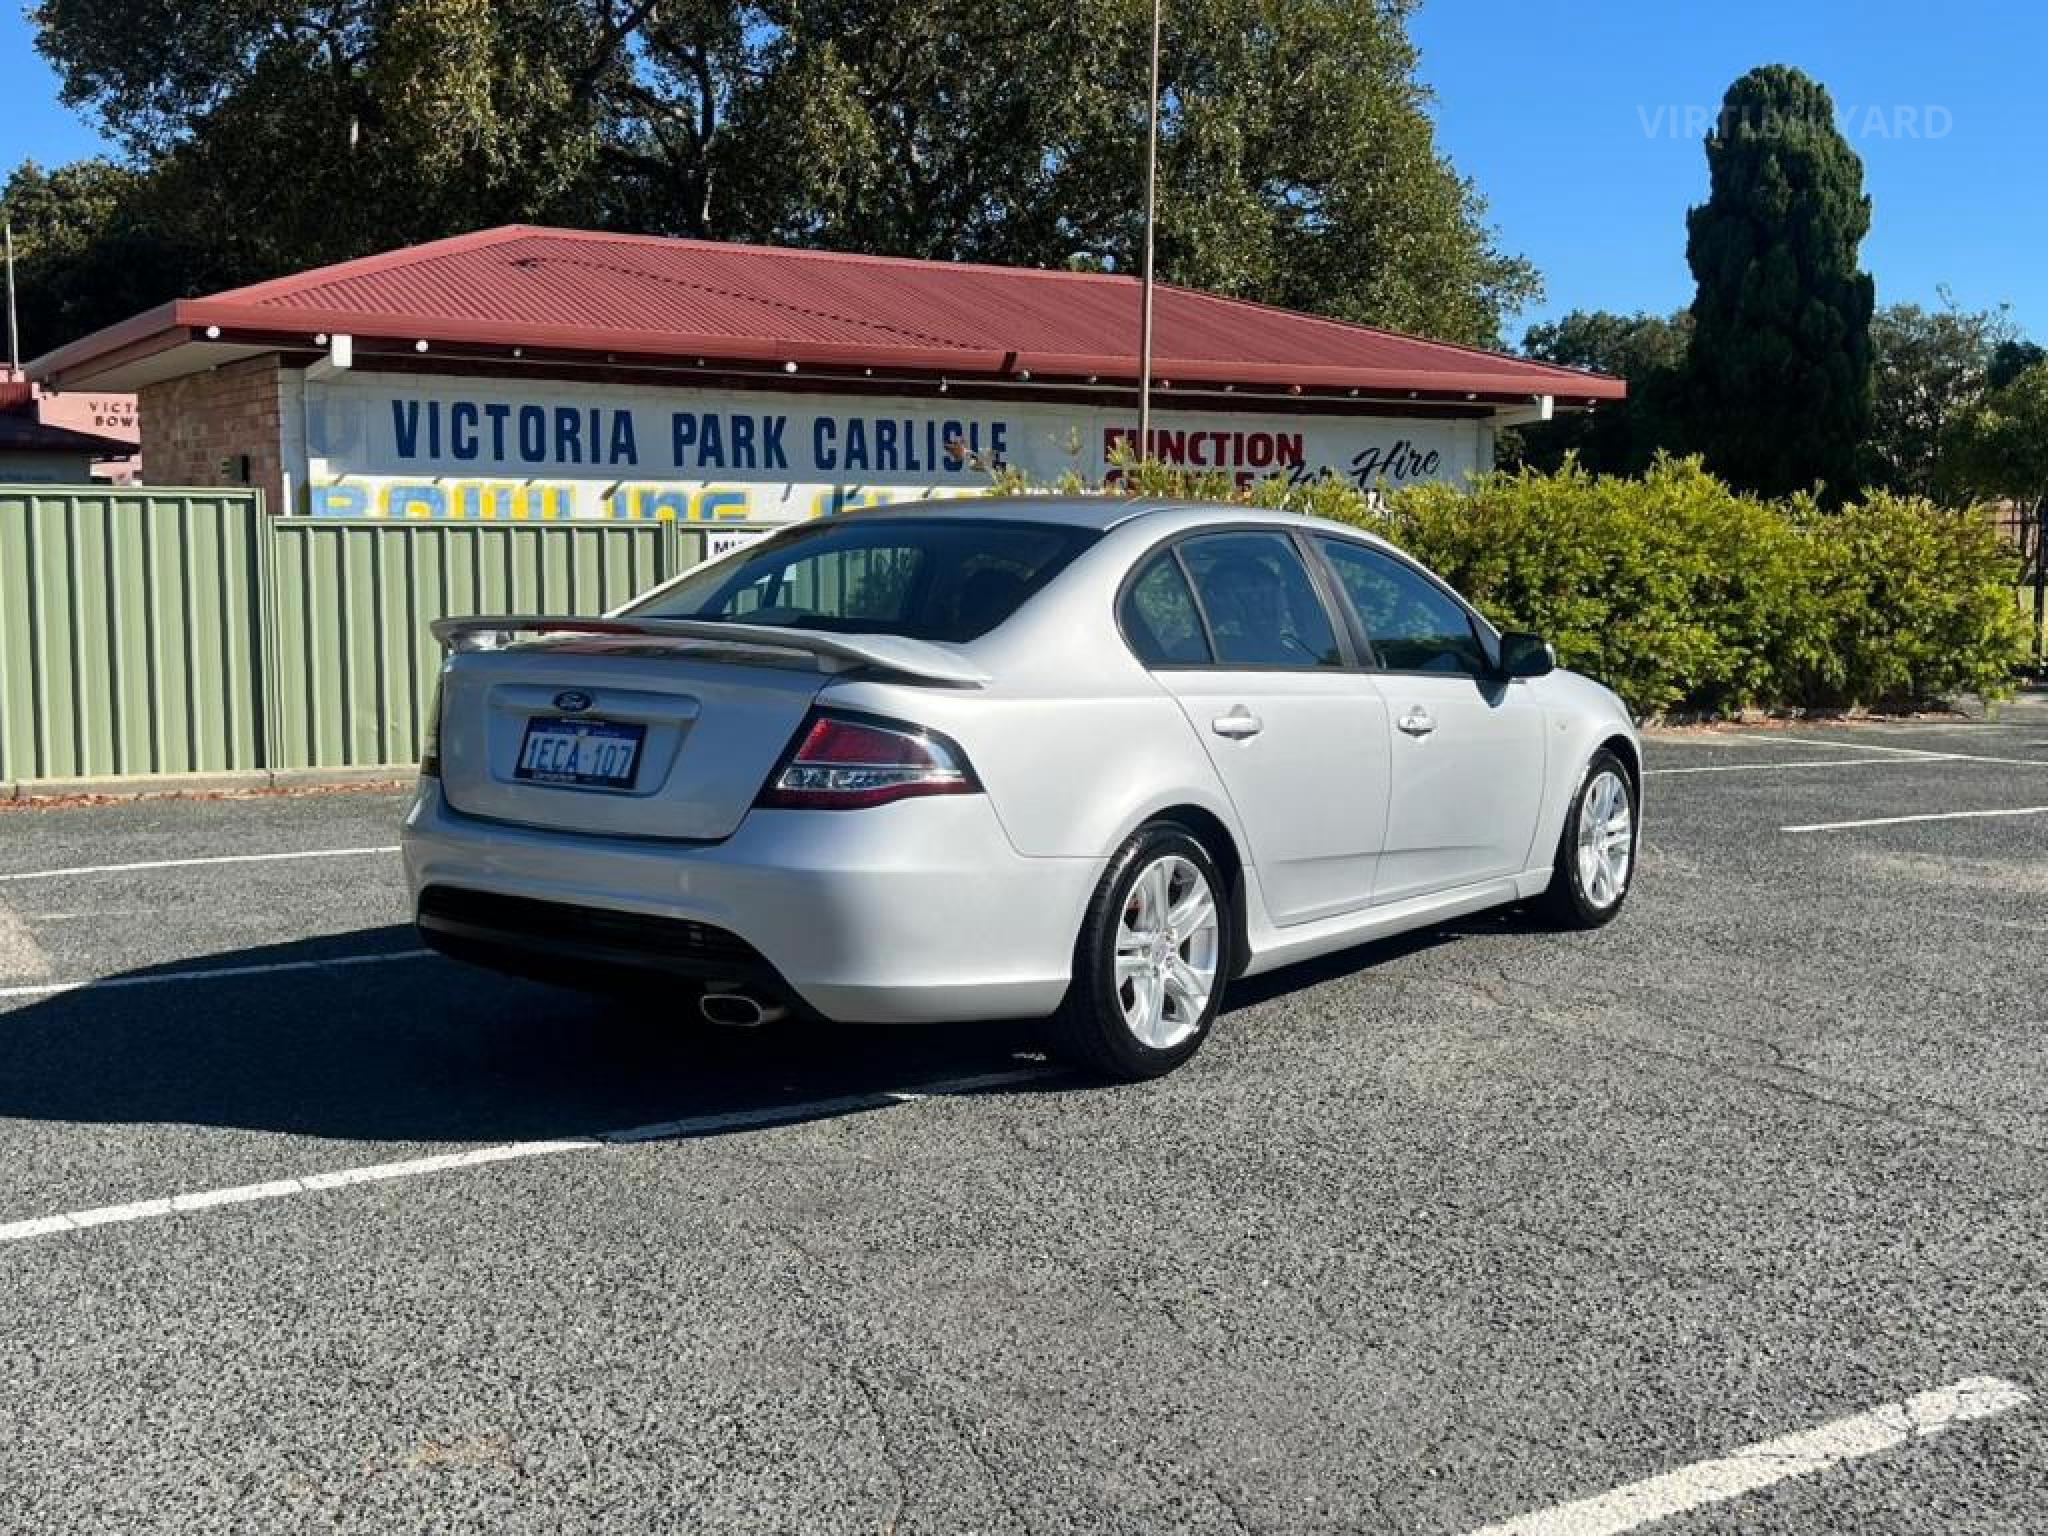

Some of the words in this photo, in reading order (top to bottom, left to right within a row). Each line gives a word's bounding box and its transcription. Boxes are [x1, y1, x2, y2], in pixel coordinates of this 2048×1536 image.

[391, 399, 639, 466] VICTORIA
[672, 412, 789, 470] PARK
[813, 416, 1008, 472] CARLISLE
[1348, 440, 1440, 487] Hire
